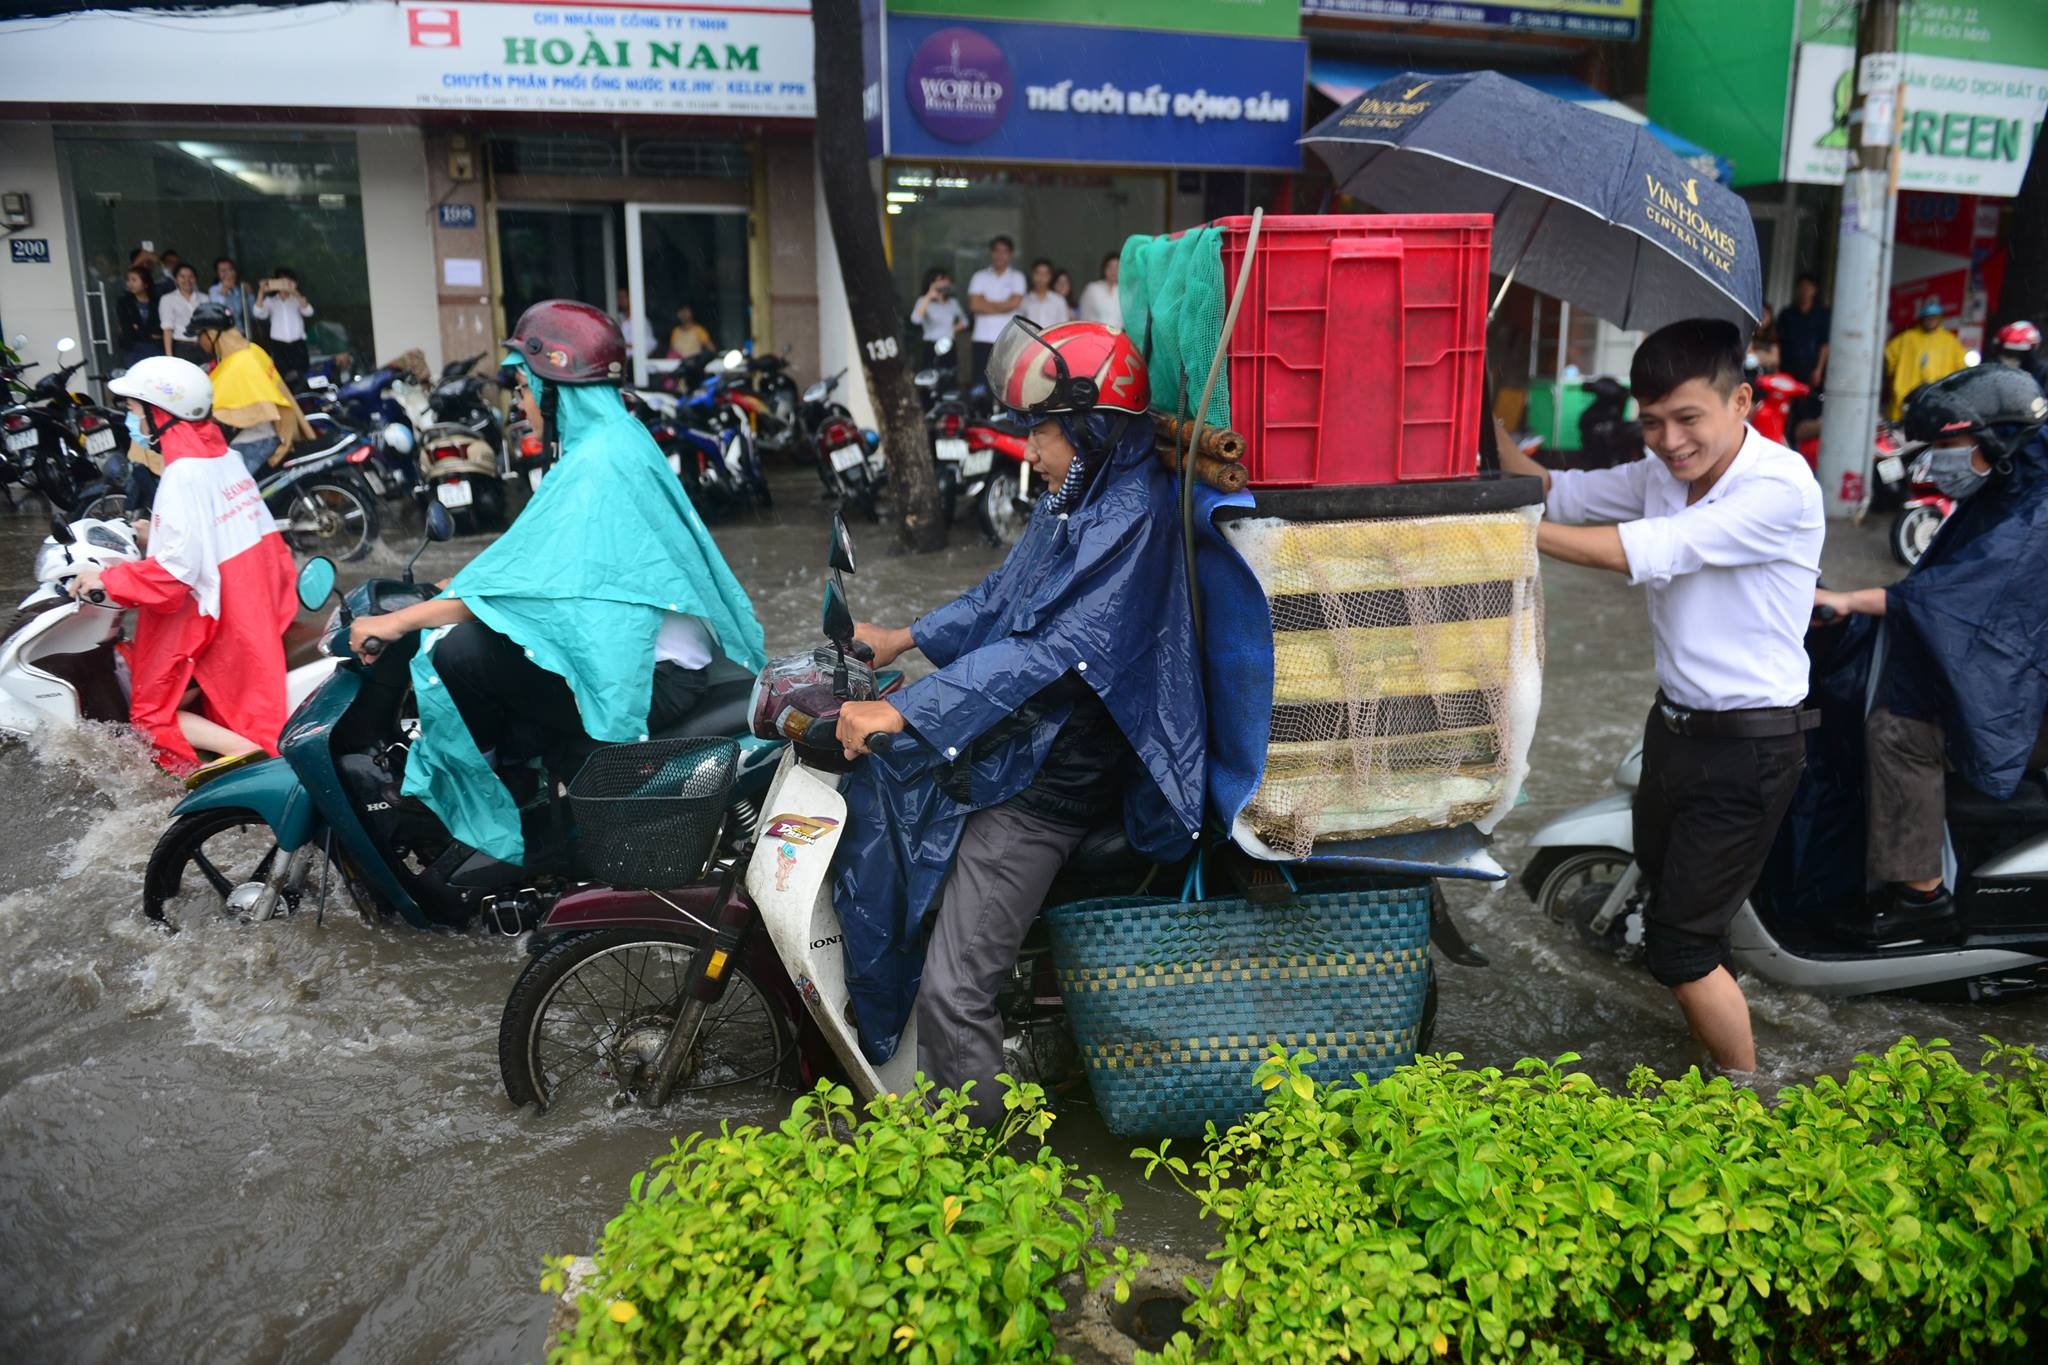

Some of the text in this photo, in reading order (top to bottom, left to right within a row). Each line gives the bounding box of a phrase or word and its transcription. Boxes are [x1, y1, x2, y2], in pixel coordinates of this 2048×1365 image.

[666, 16, 683, 29] TY
[503, 29, 761, 72] HOÀI NAM
[442, 71, 503, 89] CHUYÊN
[507, 73, 547, 89] PHÂN
[920, 77, 1003, 102] WORLD
[1930, 74, 1968, 94] GIAO
[1971, 78, 2003, 101] DỊCH
[1025, 79, 1073, 112] THẾ
[1071, 82, 1125, 114] GIỚI
[1127, 83, 1170, 116] BẤT
[1172, 88, 1242, 124] ĐỘNG
[1244, 91, 1290, 122] SẢN
[443, 205, 473, 222] 198
[1645, 172, 1736, 257] VINHOMES
[14, 240, 46, 257] 200
[1646, 206, 1731, 274] CENTRAL PARK
[866, 336, 898, 361] 139
[366, 801, 392, 812] HO
